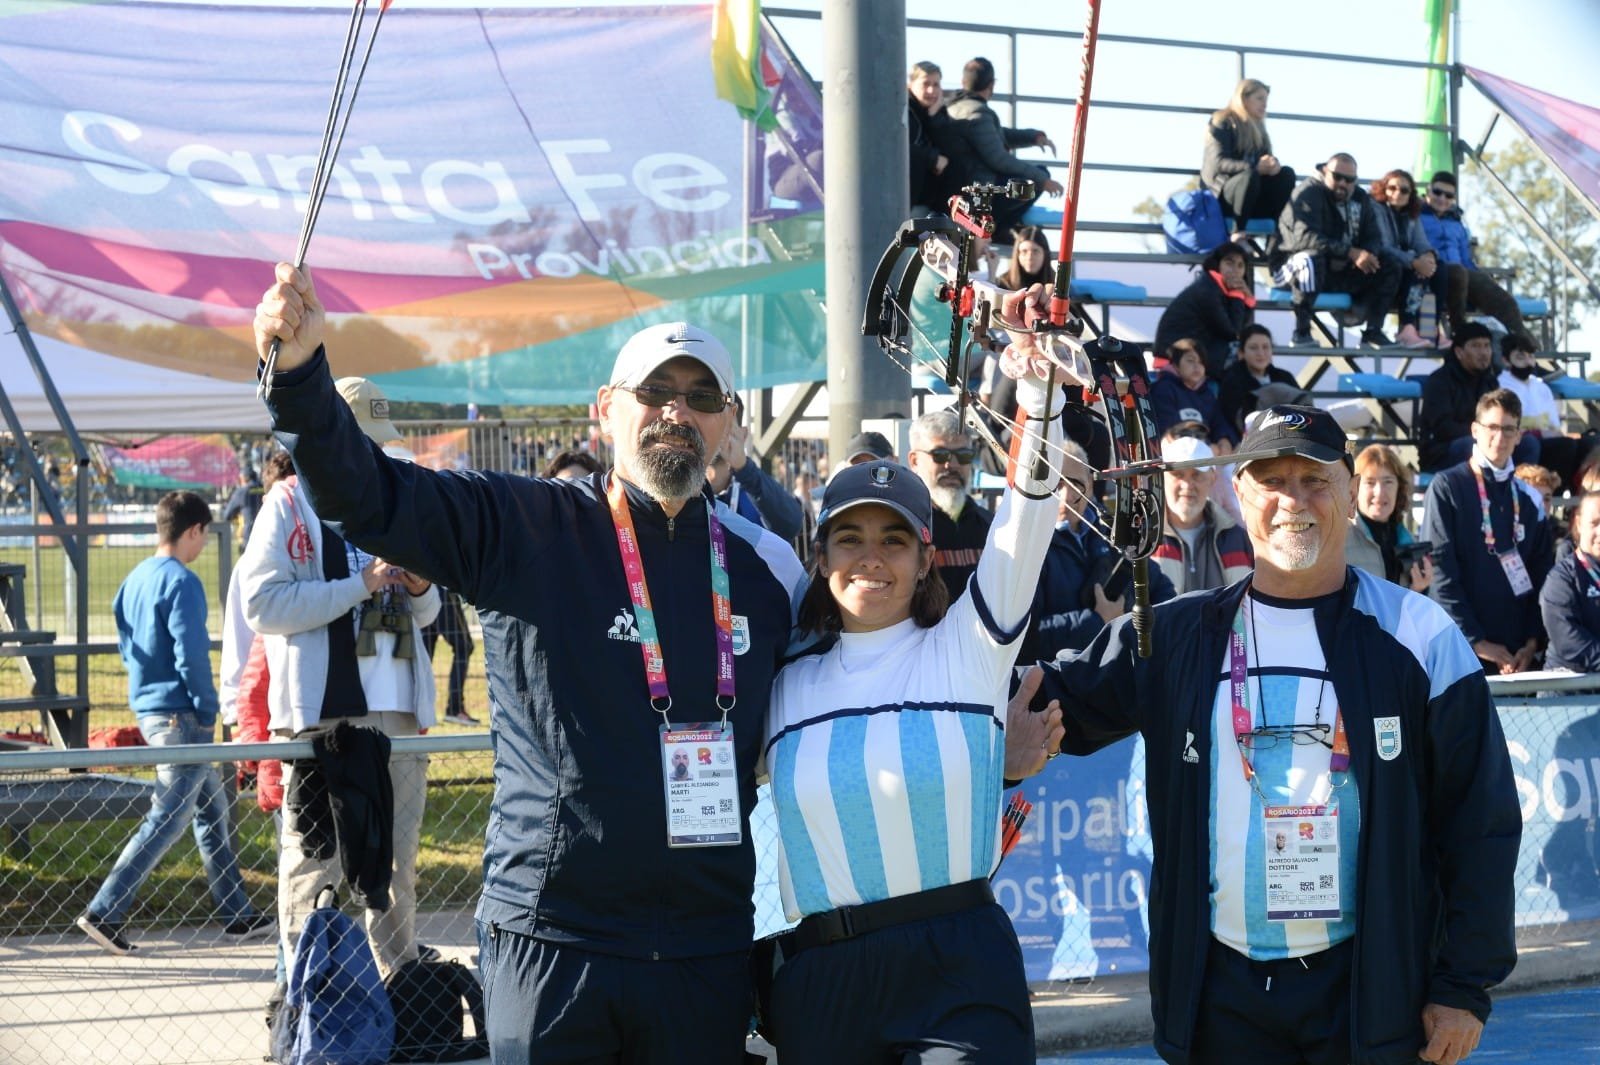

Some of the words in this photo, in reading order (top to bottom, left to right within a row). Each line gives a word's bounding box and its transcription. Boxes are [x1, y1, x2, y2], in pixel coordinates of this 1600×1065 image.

[62, 110, 533, 225] Santa
[539, 138, 732, 221] Fe
[466, 230, 772, 280] Provincia
